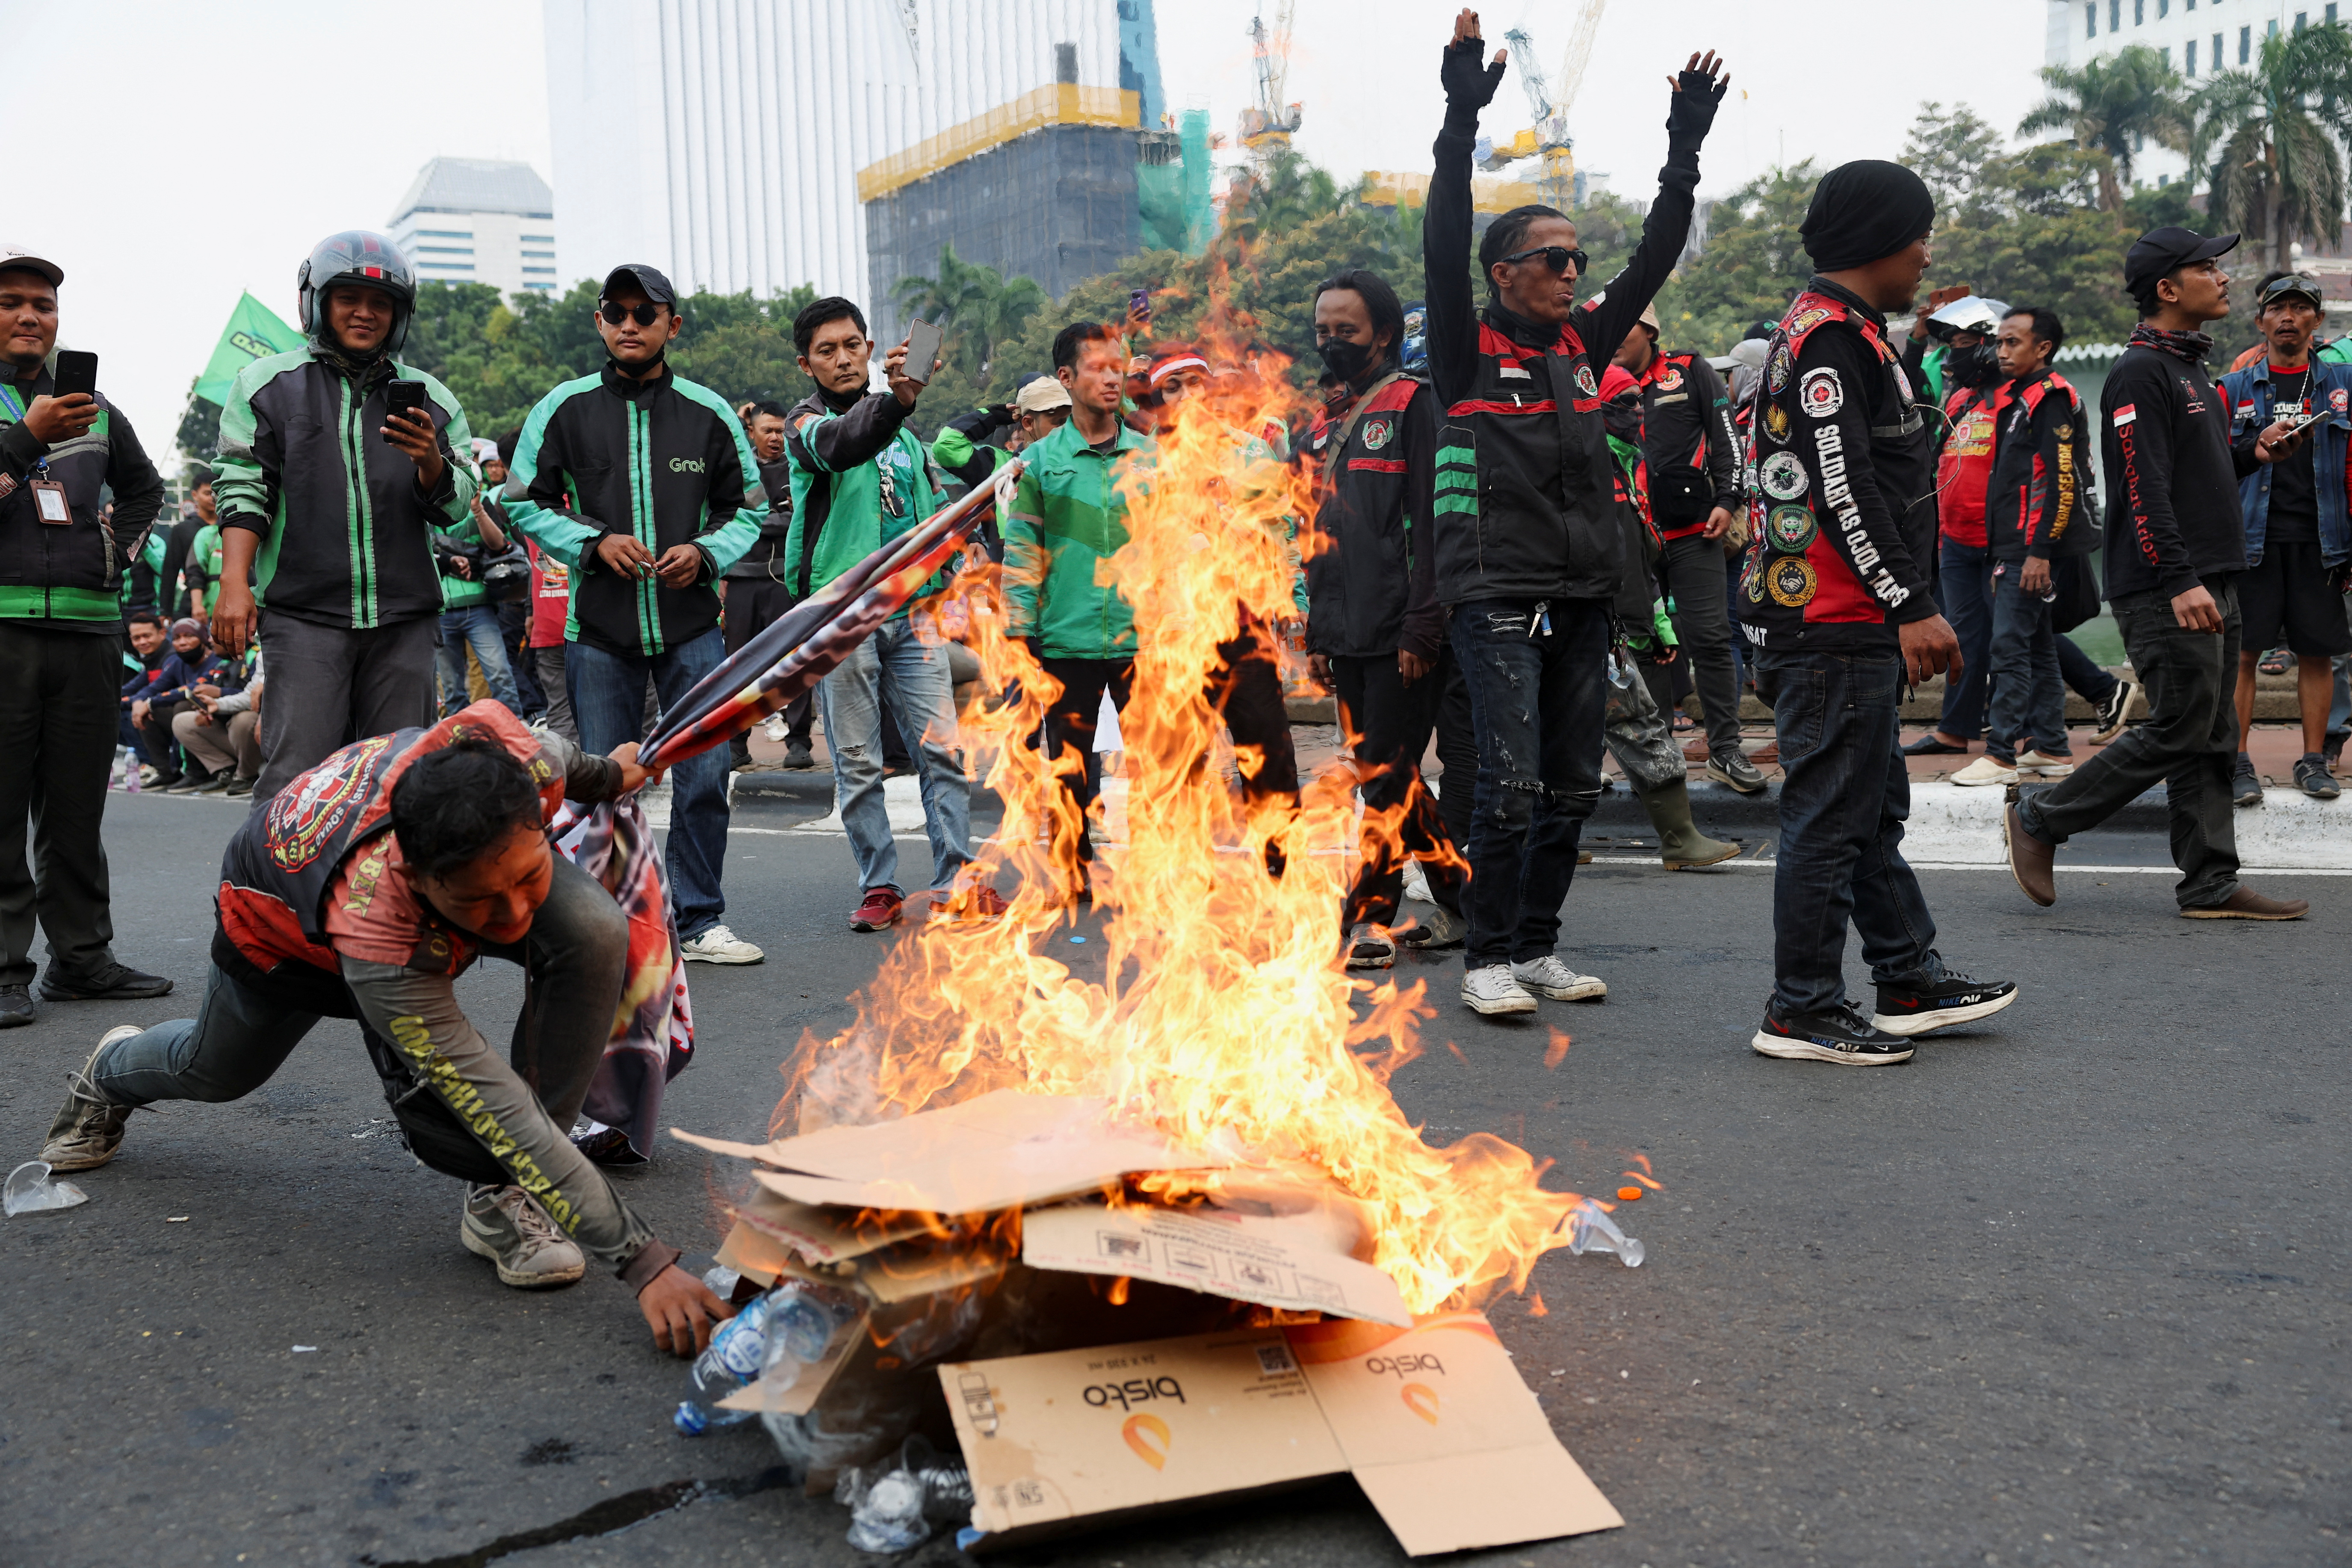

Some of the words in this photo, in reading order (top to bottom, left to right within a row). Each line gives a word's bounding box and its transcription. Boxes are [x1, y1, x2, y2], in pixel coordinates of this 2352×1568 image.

[6, 401, 19, 414] General
[1720, 409, 1741, 466] JABODETABEK
[669, 458, 705, 474] Grab
[1761, 468, 1767, 476] MY
[1764, 454, 1779, 468] ONLINE
[2058, 443, 2074, 491] SELATAN
[1814, 424, 1862, 532] SOLIDARITAS
[1846, 529, 1881, 576] OJOL
[2119, 424, 2142, 510] Sahabat
[2134, 514, 2159, 565] Arion
[1785, 535, 1809, 548] COMMUNITY
[1740, 622, 1767, 647] USAT
[529, 759, 552, 783] 18
[316, 806, 345, 846] SQUAD
[1938, 996, 1961, 1006] NIKE
[1810, 1036, 1835, 1048] NIKE
[1366, 1353, 1446, 1379] bisto
[1084, 1376, 1185, 1411] bisto
